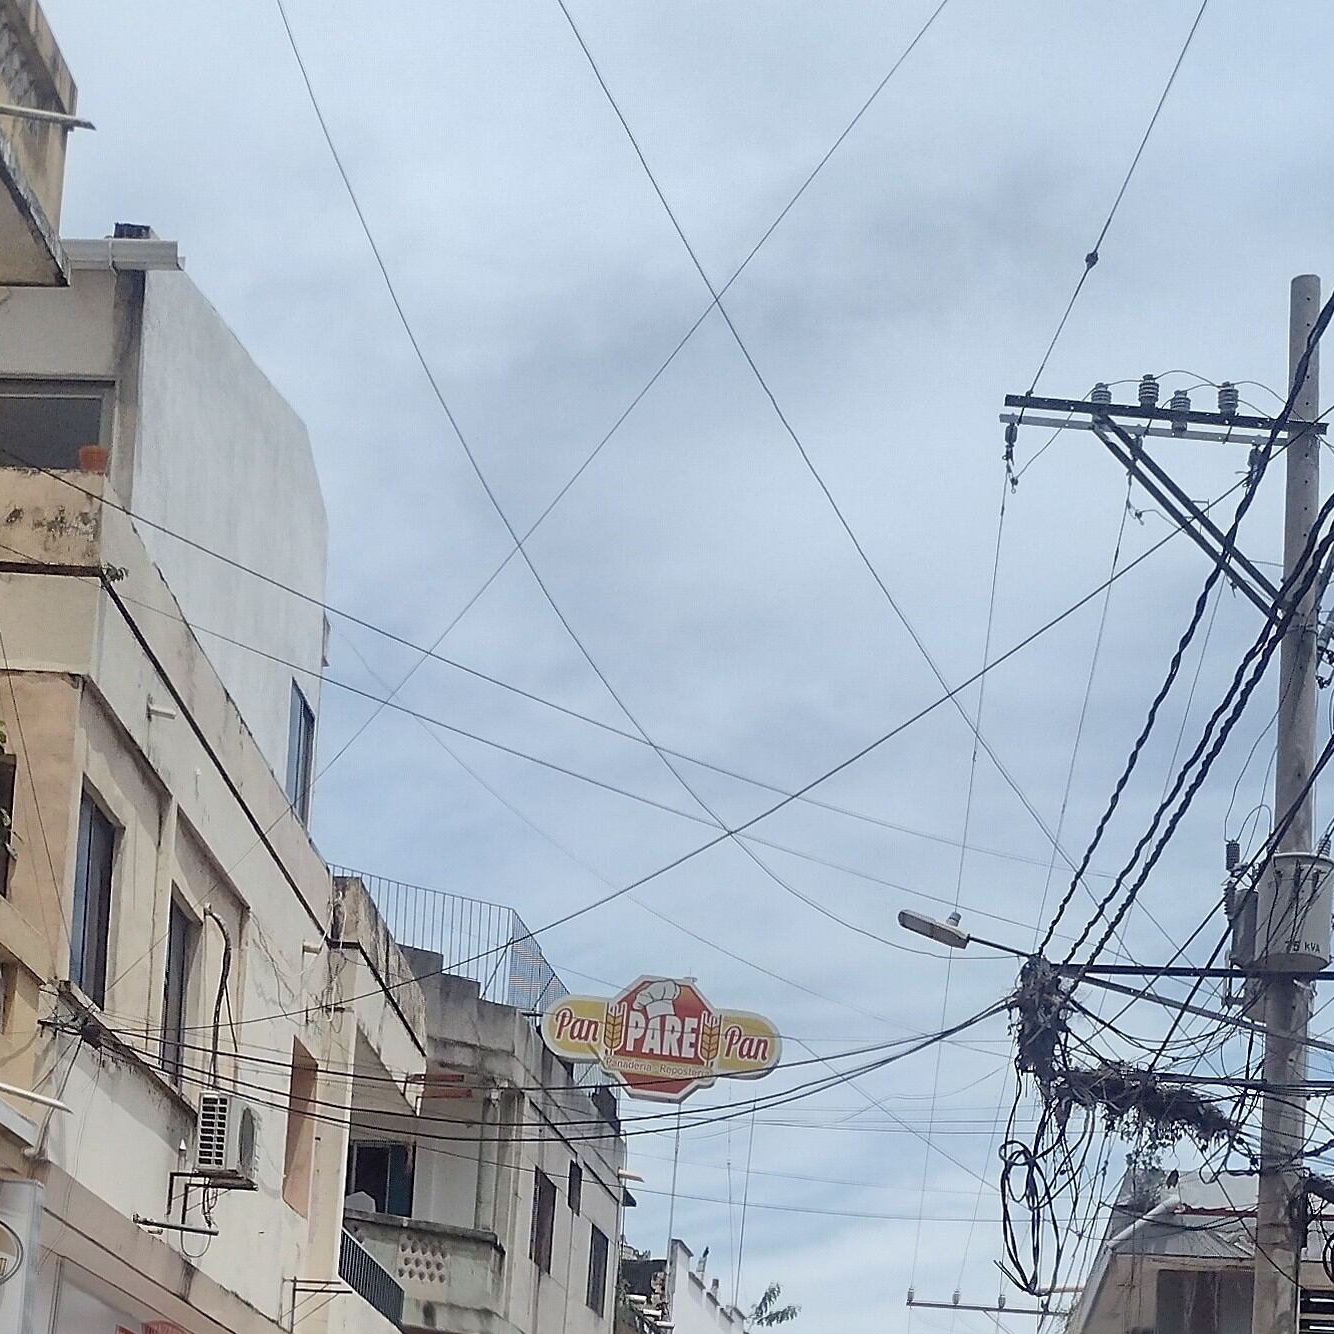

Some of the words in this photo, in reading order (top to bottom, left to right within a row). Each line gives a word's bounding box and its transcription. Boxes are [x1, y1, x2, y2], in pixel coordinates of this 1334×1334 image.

[555, 1007, 599, 1043] Pan
[626, 1010, 698, 1058] PARE
[723, 1024, 769, 1062] Pan
